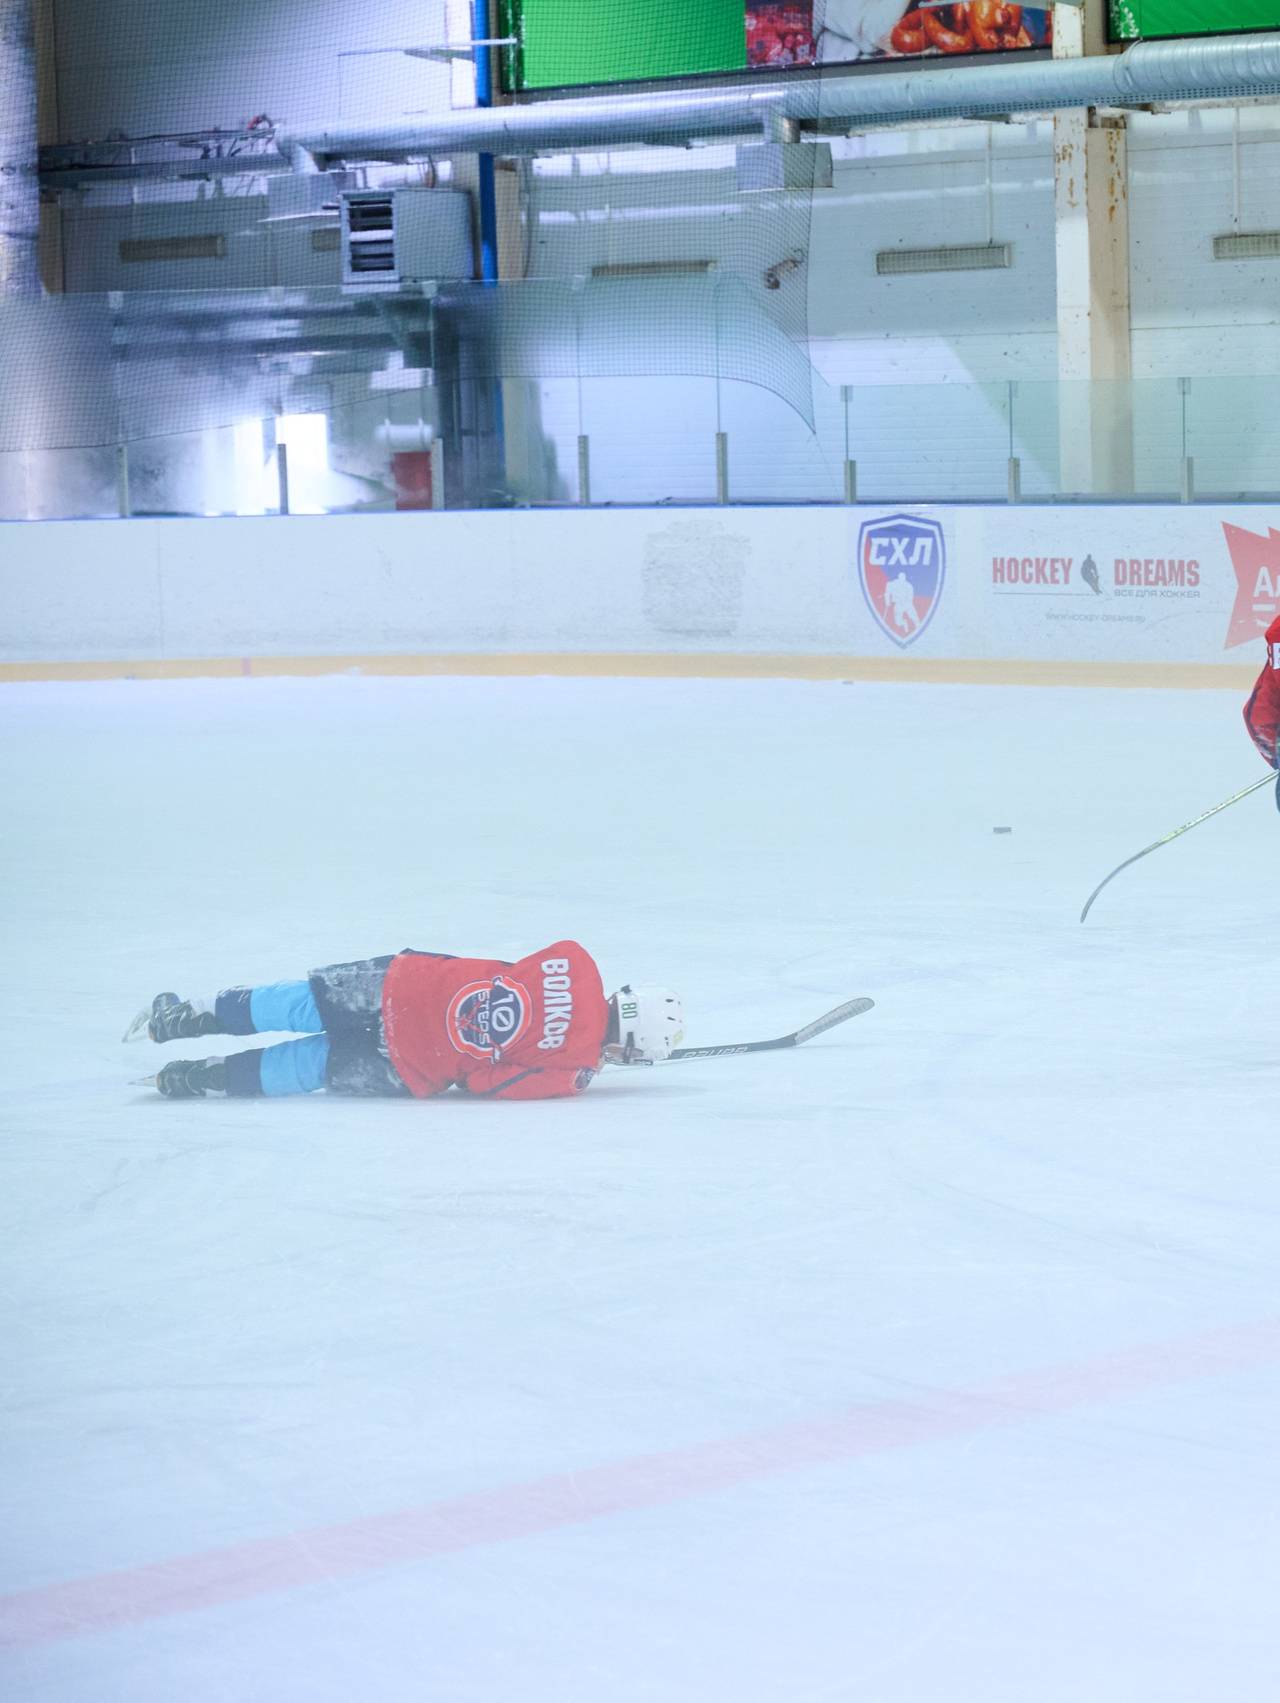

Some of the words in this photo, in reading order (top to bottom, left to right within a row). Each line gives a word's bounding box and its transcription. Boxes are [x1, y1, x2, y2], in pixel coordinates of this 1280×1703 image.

[868, 536, 933, 566] СХЛ
[992, 557, 1073, 585] HOCKEY
[1114, 558, 1200, 587] DREAMS
[1114, 589, 1135, 598] ВСЕ
[1136, 590, 1157, 599] ДЛЯ
[1159, 590, 1200, 599] ХОККЕЯ
[477, 990, 490, 1045] STEPS
[491, 993, 516, 1032] 10
[537, 958, 573, 1050] ВОЛКОВ
